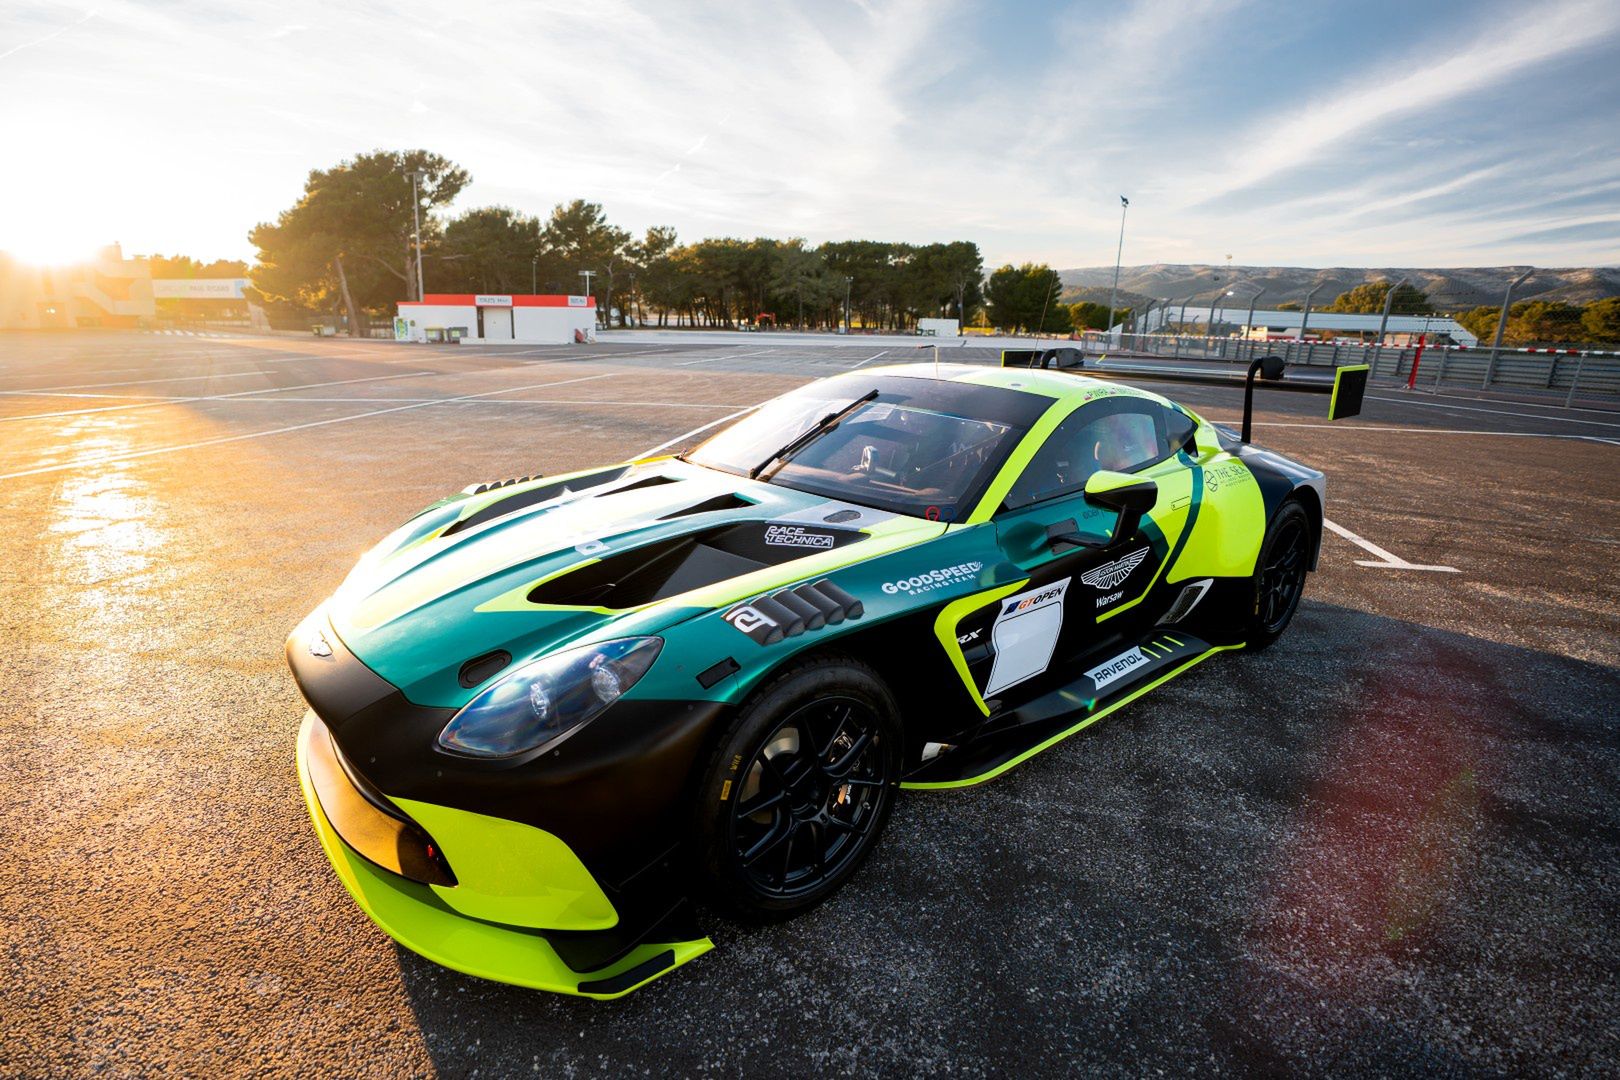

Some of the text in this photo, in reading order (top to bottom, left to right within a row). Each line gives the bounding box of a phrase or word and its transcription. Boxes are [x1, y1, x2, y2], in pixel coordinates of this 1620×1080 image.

[765, 526, 805, 535] RACE
[768, 534, 832, 546] TECHNICA
[881, 561, 983, 594] GOODSPEED
[1096, 590, 1124, 608] Warsaw
[1093, 653, 1143, 683] RAVENOL
